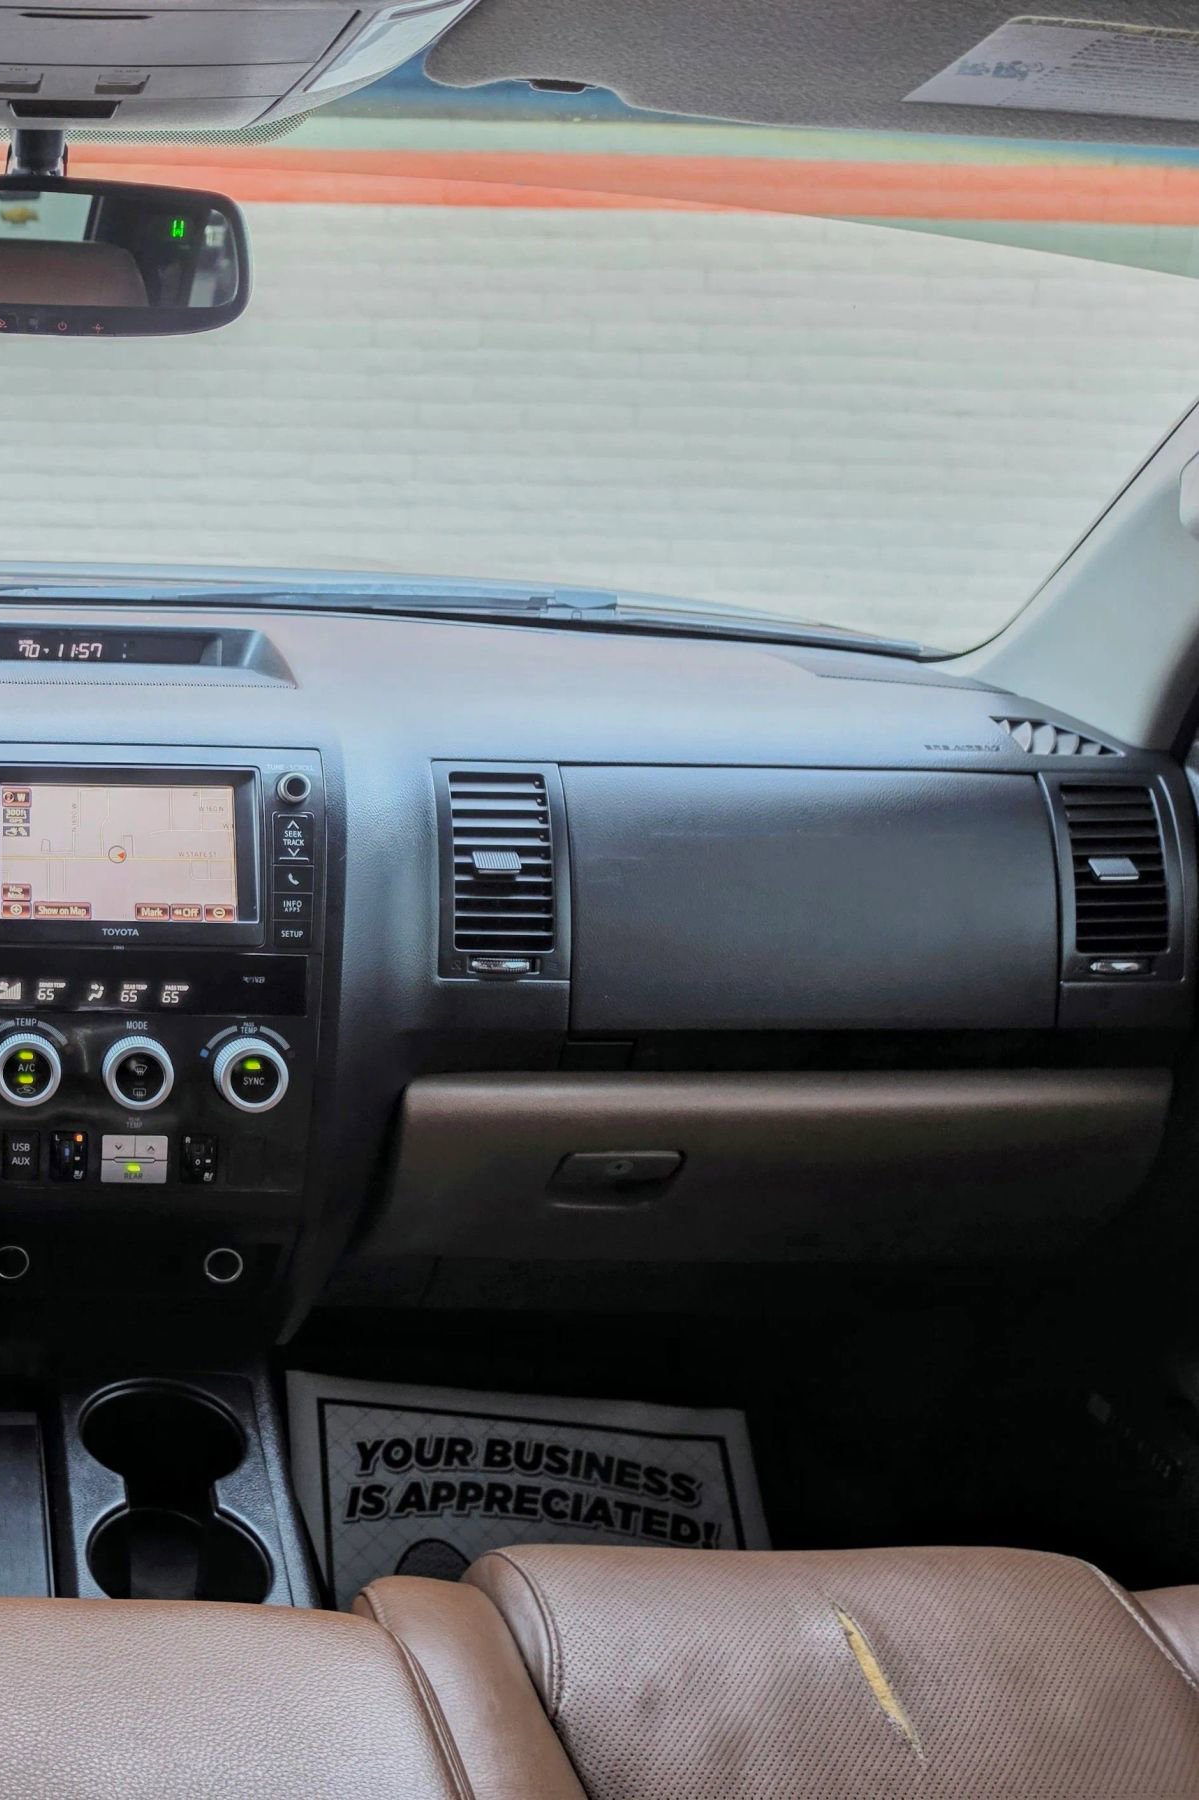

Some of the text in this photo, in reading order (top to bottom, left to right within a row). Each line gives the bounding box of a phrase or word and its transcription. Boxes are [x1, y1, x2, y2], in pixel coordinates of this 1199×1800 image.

[57, 643, 103, 659] 11:57
[284, 830, 302, 838] SEEK
[283, 838, 305, 846] TRACK
[38, 905, 87, 916] Show on Map
[141, 907, 163, 916] Mark
[182, 907, 199, 917] Off
[101, 928, 140, 937] TOYOTA
[281, 930, 304, 938] SETUP
[37, 988, 55, 1001] 65
[120, 990, 138, 1003] 65
[161, 991, 179, 1004] 65
[15, 1017, 38, 1027] TEMP
[126, 1021, 149, 1030] MODE
[241, 1026, 258, 1034] TEMP
[17, 1063, 36, 1073] A/C
[243, 1077, 265, 1086] SYNC
[11, 1143, 31, 1152] USB
[11, 1156, 31, 1166] AUX
[356, 1437, 702, 1503] YOUR BUSINESS
[346, 1480, 718, 1548] IS APPRECIATED!
